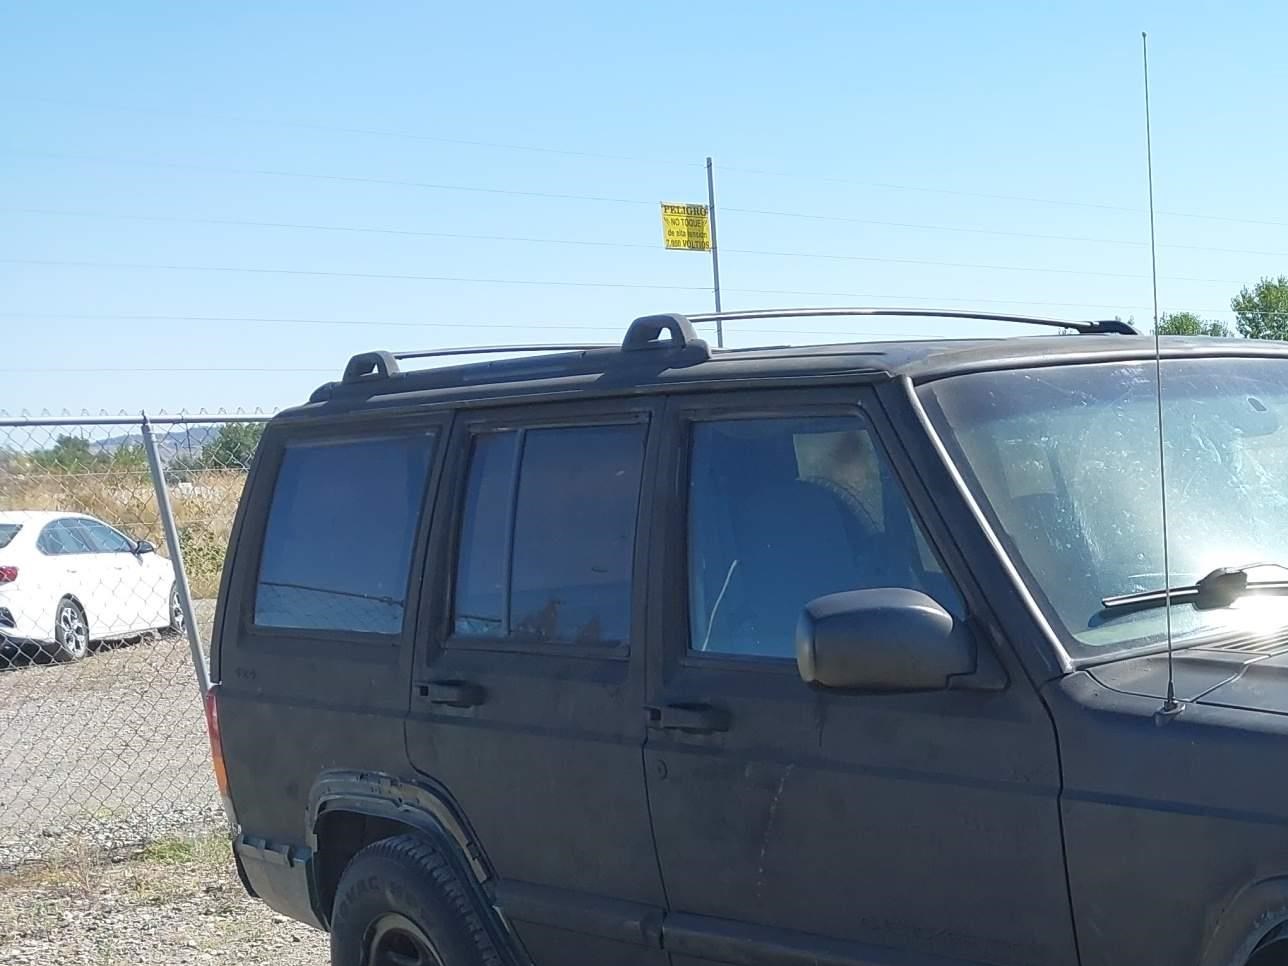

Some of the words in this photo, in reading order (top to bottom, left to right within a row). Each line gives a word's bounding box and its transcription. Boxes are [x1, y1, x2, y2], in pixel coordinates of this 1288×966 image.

[664, 205, 707, 216] PELIGRO
[671, 218, 680, 226] NO
[683, 239, 709, 249] VOLTIOS
